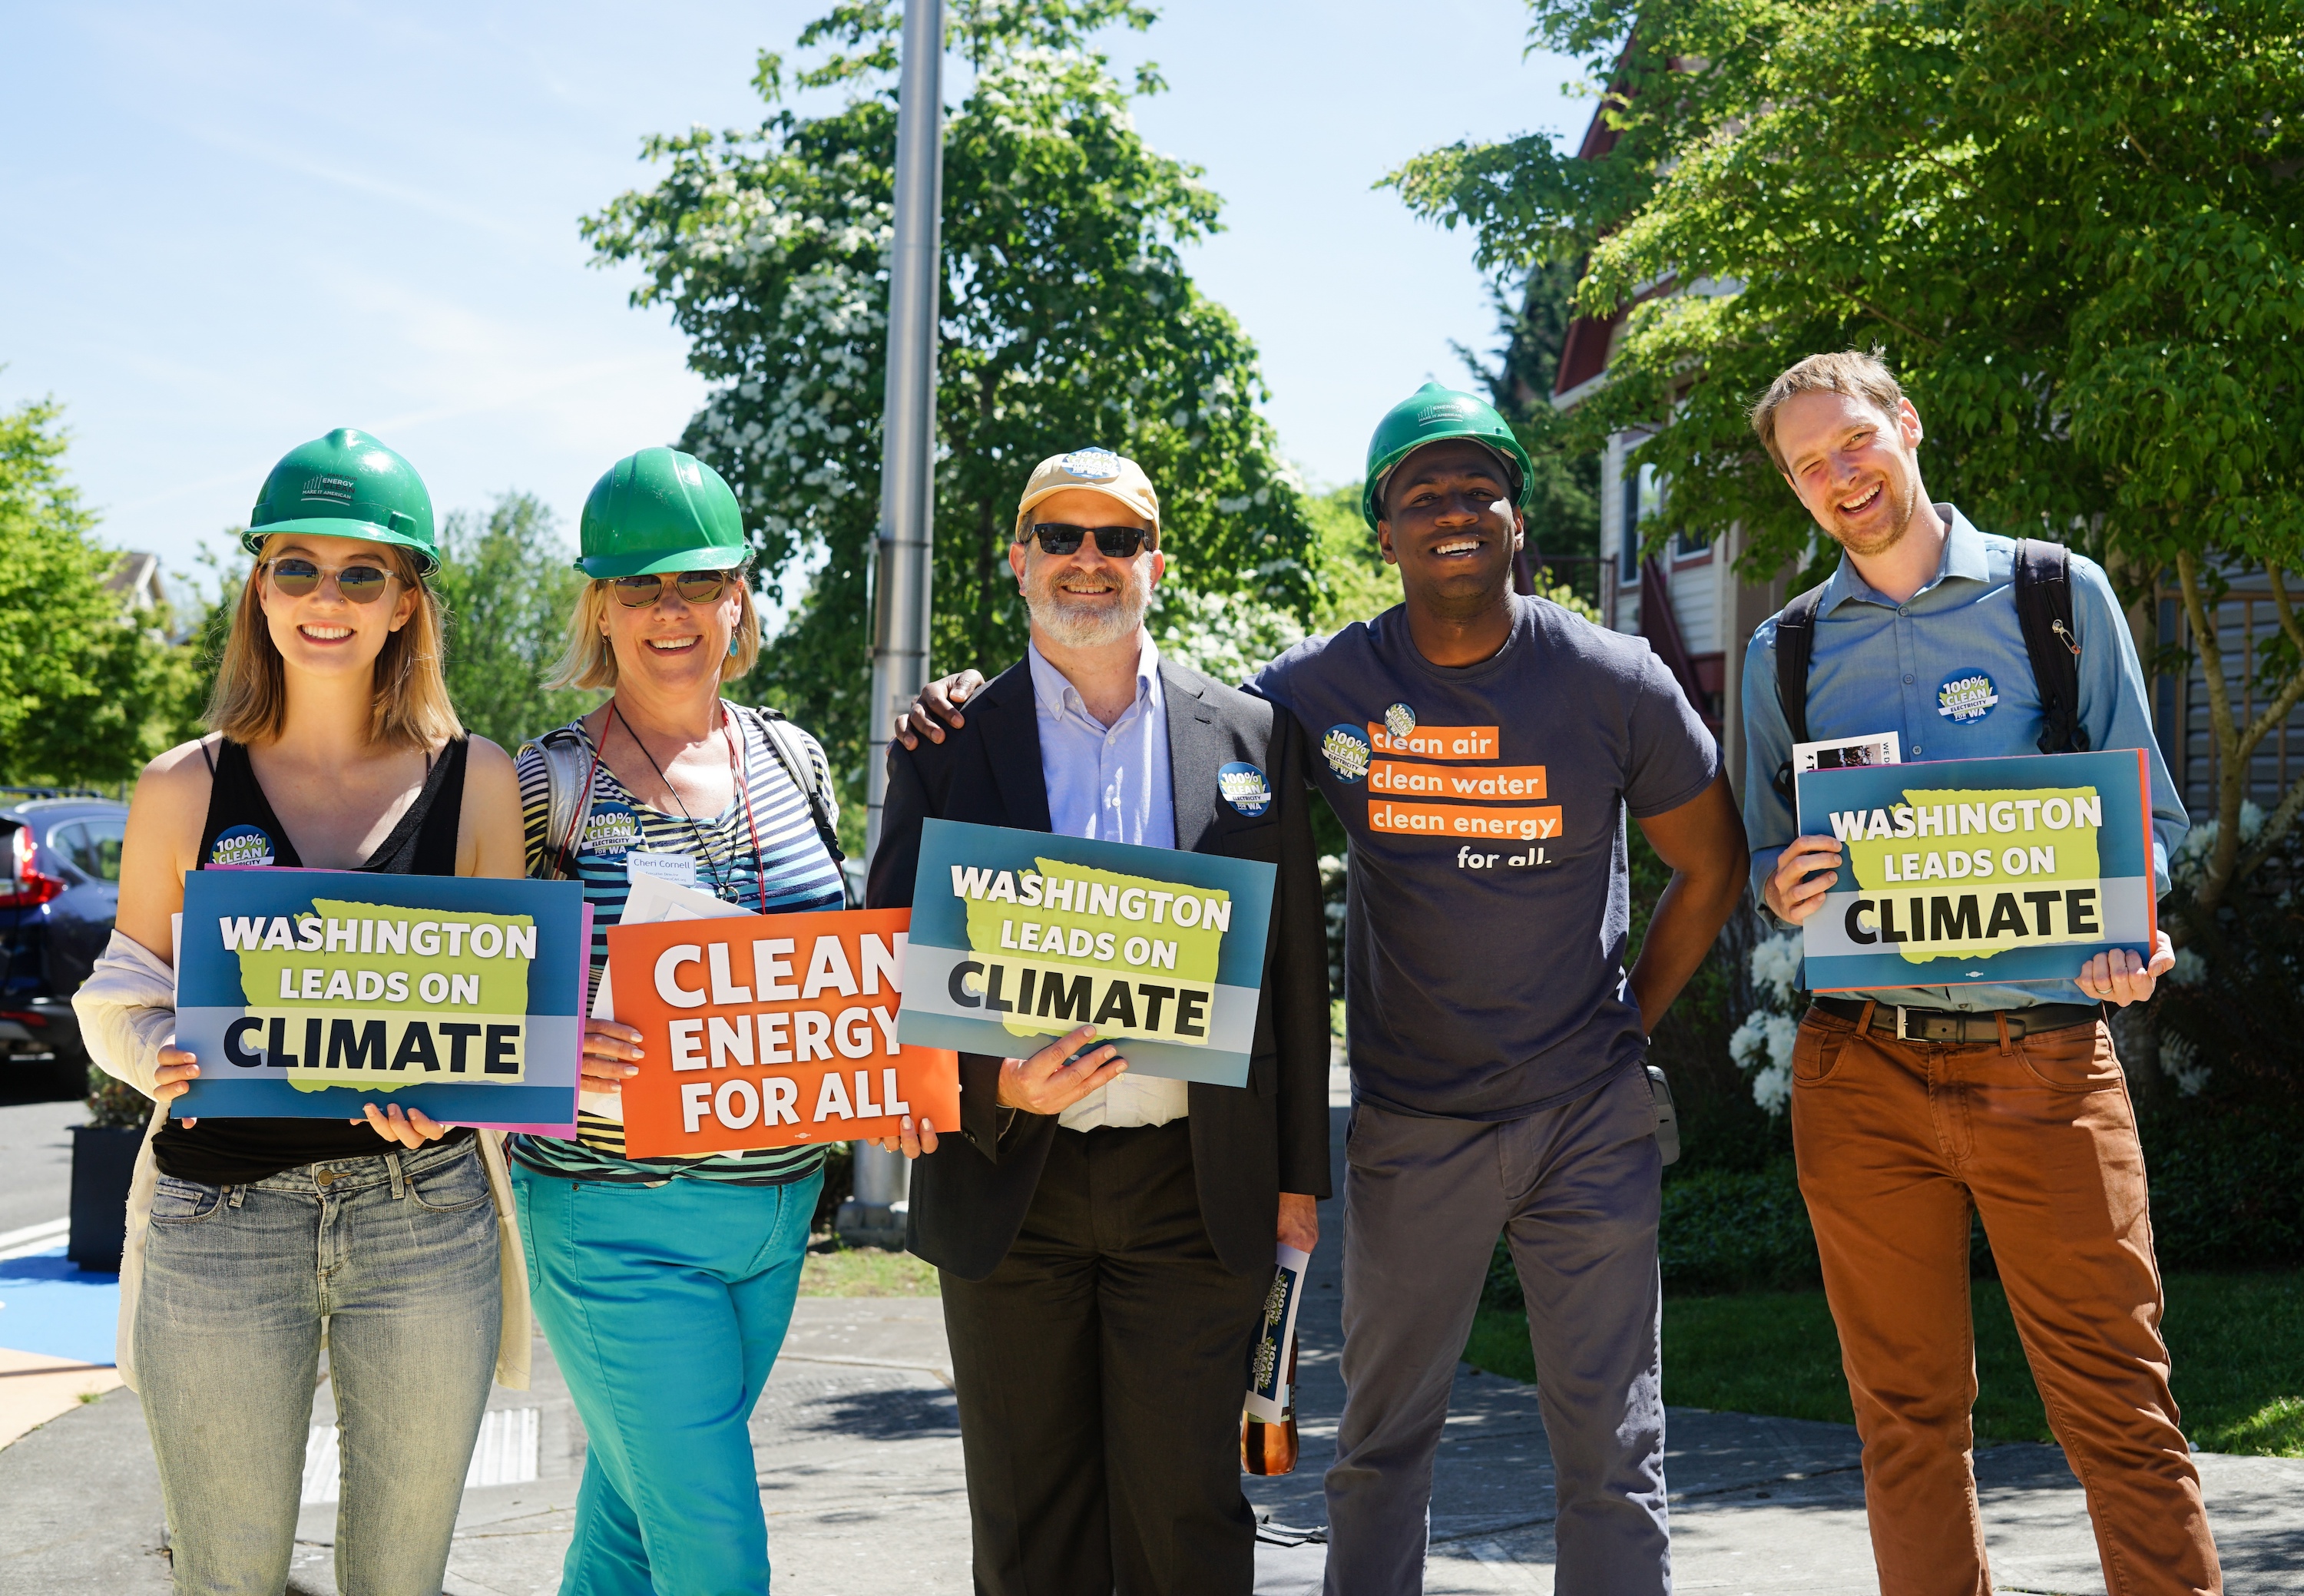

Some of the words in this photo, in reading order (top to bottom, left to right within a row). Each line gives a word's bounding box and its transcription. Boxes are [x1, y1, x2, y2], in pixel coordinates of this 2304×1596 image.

[1072, 458, 1114, 469] CLEAN
[323, 478, 354, 488] ENERGY
[323, 483, 356, 494] CLEAN
[323, 490, 351, 499] AMERICAN
[1943, 675, 1985, 694] 100%
[1946, 688, 1987, 706] CLEAN
[1951, 700, 1987, 712] ELECTRICITY
[1392, 710, 1408, 730] CLEAN
[1397, 704, 1413, 727] 100%
[1968, 707, 1986, 717] WA
[1332, 730, 1367, 754] 100%
[1373, 732, 1443, 754] clean
[1452, 731, 1491, 754] air
[1883, 742, 1890, 755] WE
[1328, 743, 1363, 765] CLEAN
[1329, 753, 1359, 770] ELECTRICITY
[1222, 771, 1258, 784] 100%
[1340, 767, 1353, 780] WA
[1372, 764, 1443, 792] clean
[1451, 774, 1538, 795] water
[1227, 784, 1261, 794] CLEAN
[588, 813, 631, 828] 100%
[1373, 805, 1445, 830] clean
[1454, 815, 1557, 840] energy
[1829, 795, 2103, 842] WASHINGTON
[217, 833, 263, 853] 100%
[589, 826, 631, 840] CLEAN
[592, 837, 630, 846] ELECTRICITY
[218, 847, 262, 864] CLEAN
[609, 846, 627, 855] WA
[1458, 846, 1500, 869] for
[1508, 847, 1552, 867] all.
[634, 859, 657, 867] Cheri
[659, 860, 690, 869] Cornell
[1884, 849, 1994, 882] LEADS
[2001, 846, 2056, 877] ON
[951, 865, 1232, 932] WASHINGTON
[1844, 889, 2100, 945] CLIMATE
[219, 916, 537, 959] WASHINGTON
[1000, 919, 1116, 962] LEADS
[1124, 936, 1177, 969] ON
[654, 932, 909, 1008] CLEAN
[280, 968, 409, 1003] LEADS
[419, 972, 480, 1005] ON
[948, 960, 1209, 1038] CLIMATE
[223, 1016, 521, 1074] CLIMATE
[668, 1005, 902, 1071] ENERGY
[680, 1077, 801, 1134] FOR
[813, 1068, 910, 1123] ALL
[1270, 1280, 1282, 1320] CLEAN
[1275, 1281, 1289, 1322] 100%
[1252, 1357, 1258, 1374] WA
[1260, 1342, 1270, 1382] CLEAN
[1265, 1345, 1276, 1385] 100%
